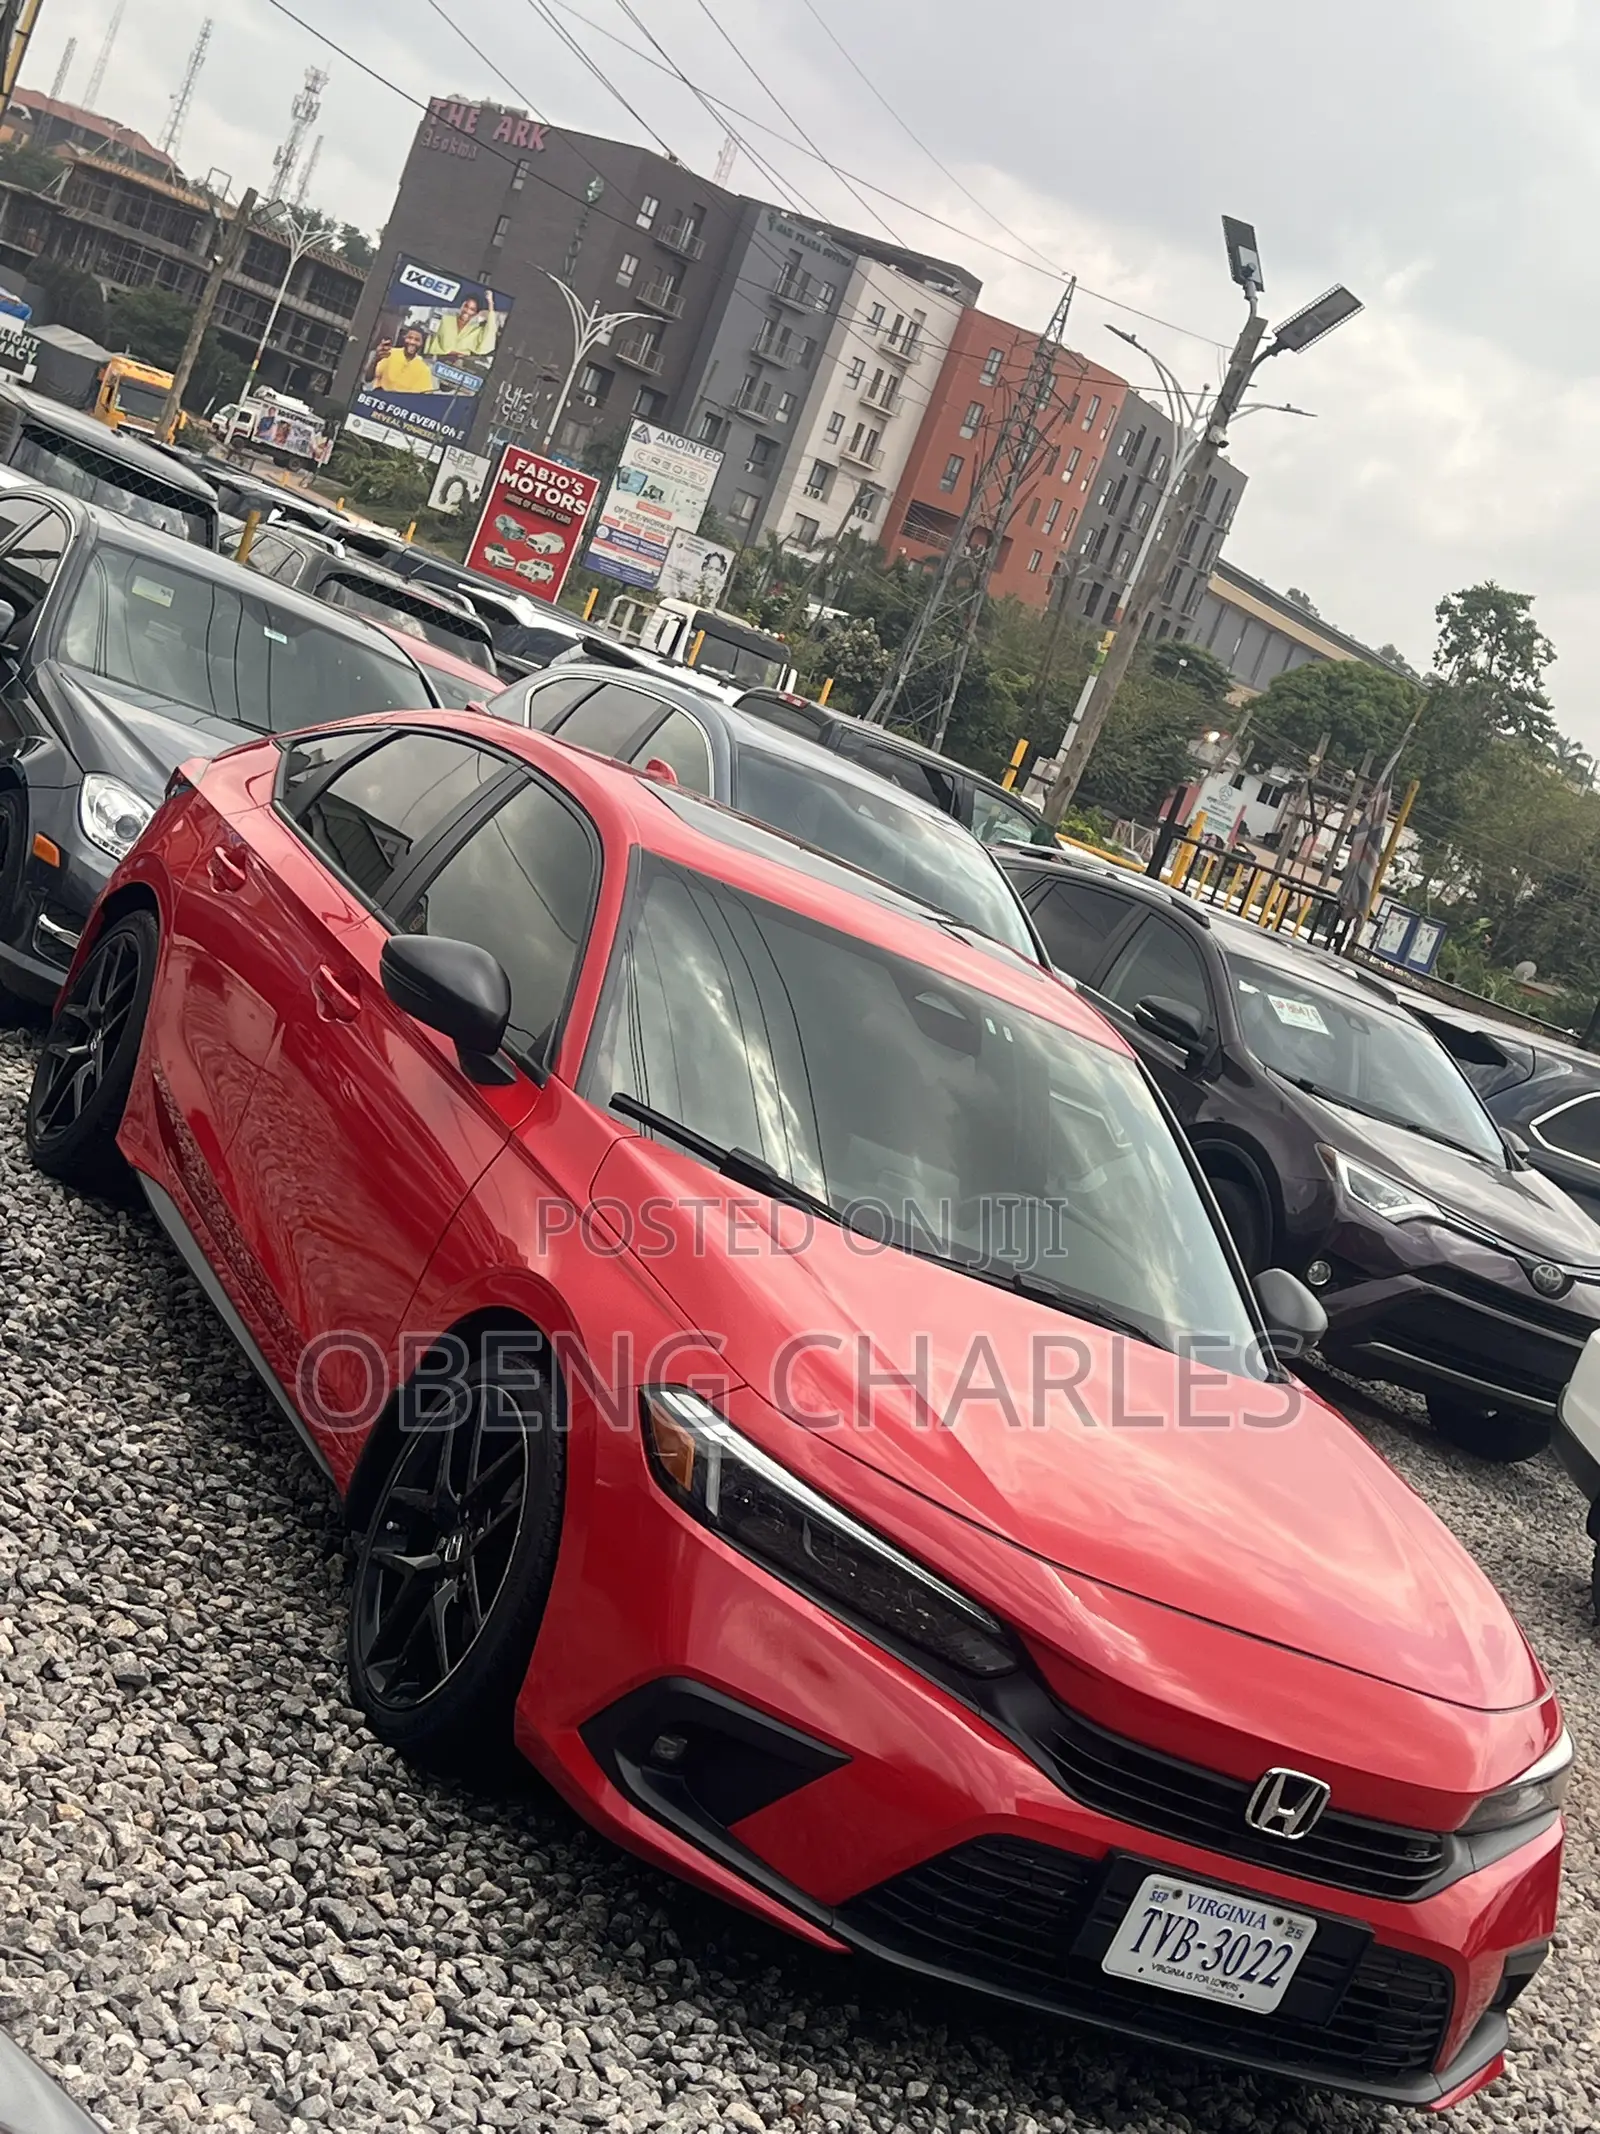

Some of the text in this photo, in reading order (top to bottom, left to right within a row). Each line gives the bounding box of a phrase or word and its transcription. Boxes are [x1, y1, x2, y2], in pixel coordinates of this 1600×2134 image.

[430, 99, 550, 151] THE ARK
[406, 270, 455, 295] 1XBET
[357, 393, 387, 410] BETS
[386, 404, 409, 420] FOR
[656, 431, 721, 464] ANOINTED
[515, 458, 584, 496] FABIO'S
[500, 469, 588, 516] MOTORS
[1149, 1890, 1169, 1904] SEP
[1187, 1893, 1269, 1931] VIRGINIA
[1285, 1926, 1303, 1940] 25
[1152, 1962, 1185, 1979] VIRGINIA
[1193, 1973, 1210, 1985] FOR
